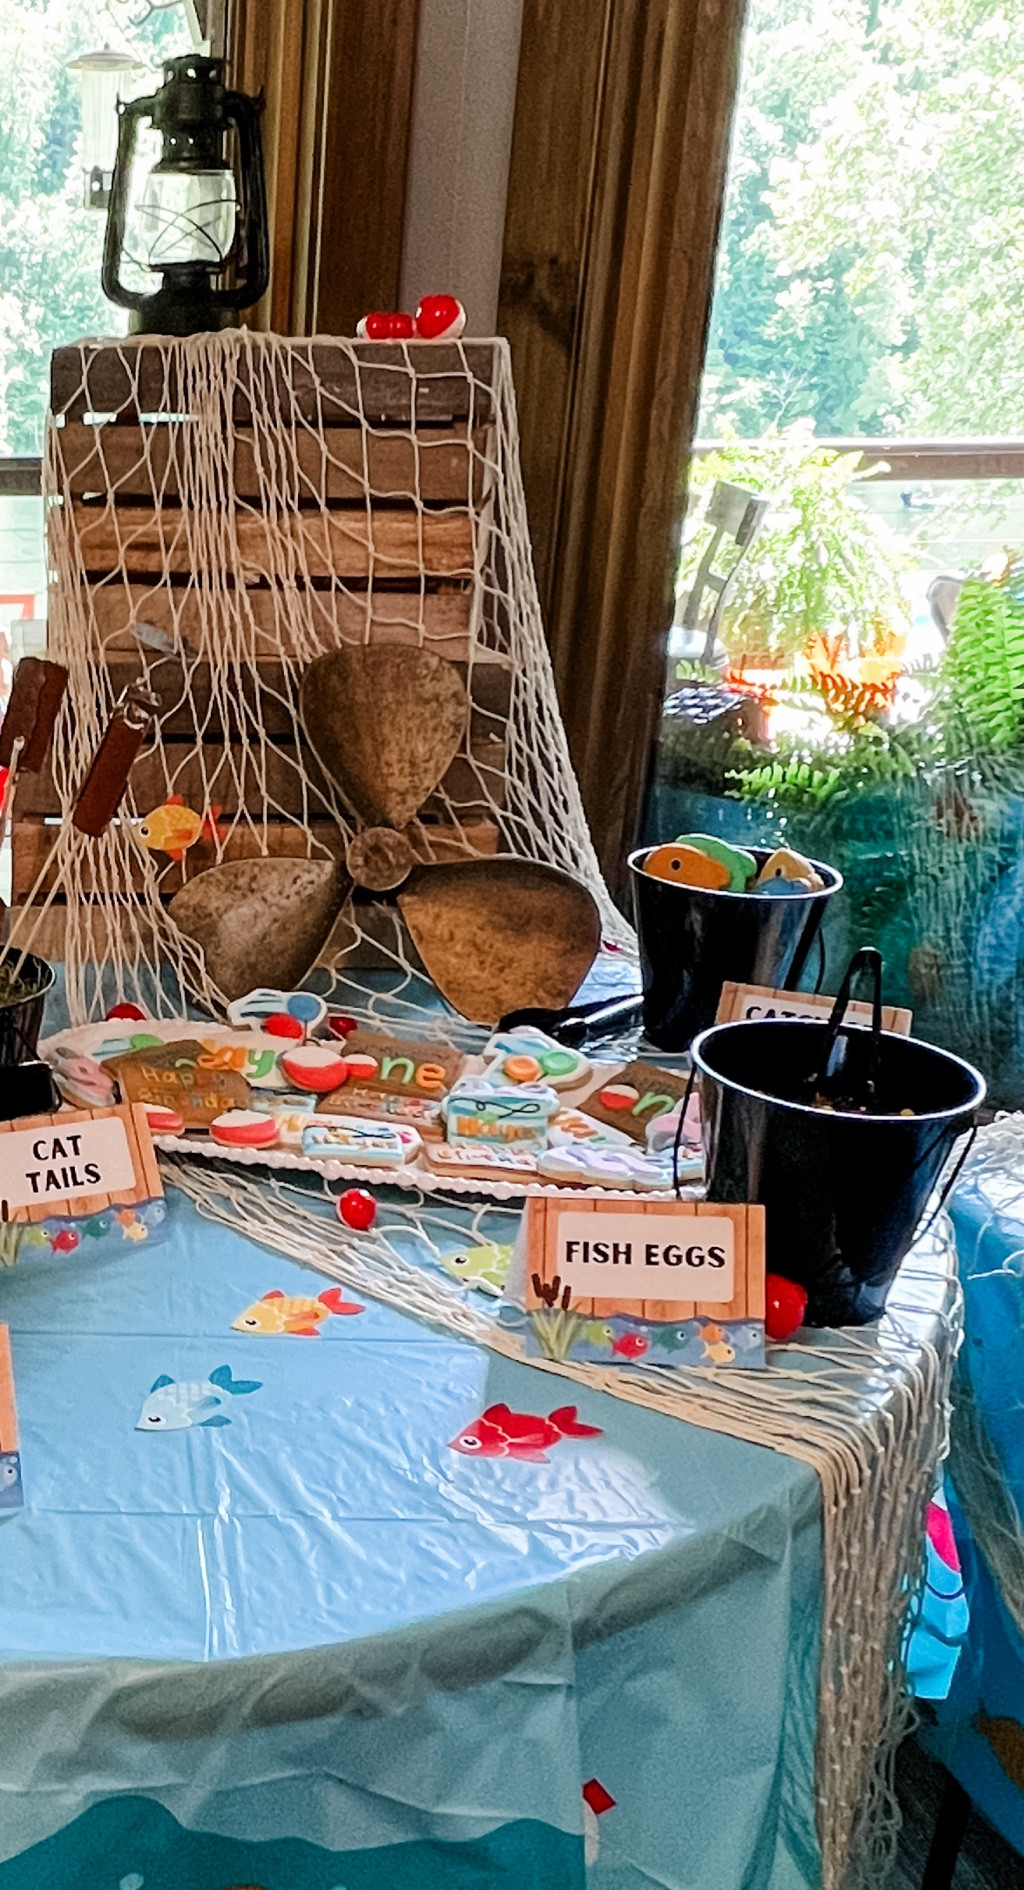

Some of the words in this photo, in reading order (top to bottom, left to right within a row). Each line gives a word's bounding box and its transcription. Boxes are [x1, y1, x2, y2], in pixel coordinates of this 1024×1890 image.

[32, 1134, 83, 1162] CAT
[25, 1163, 102, 1194] TAILS
[565, 1240, 632, 1266] FISH
[644, 1241, 726, 1269] EGGS
